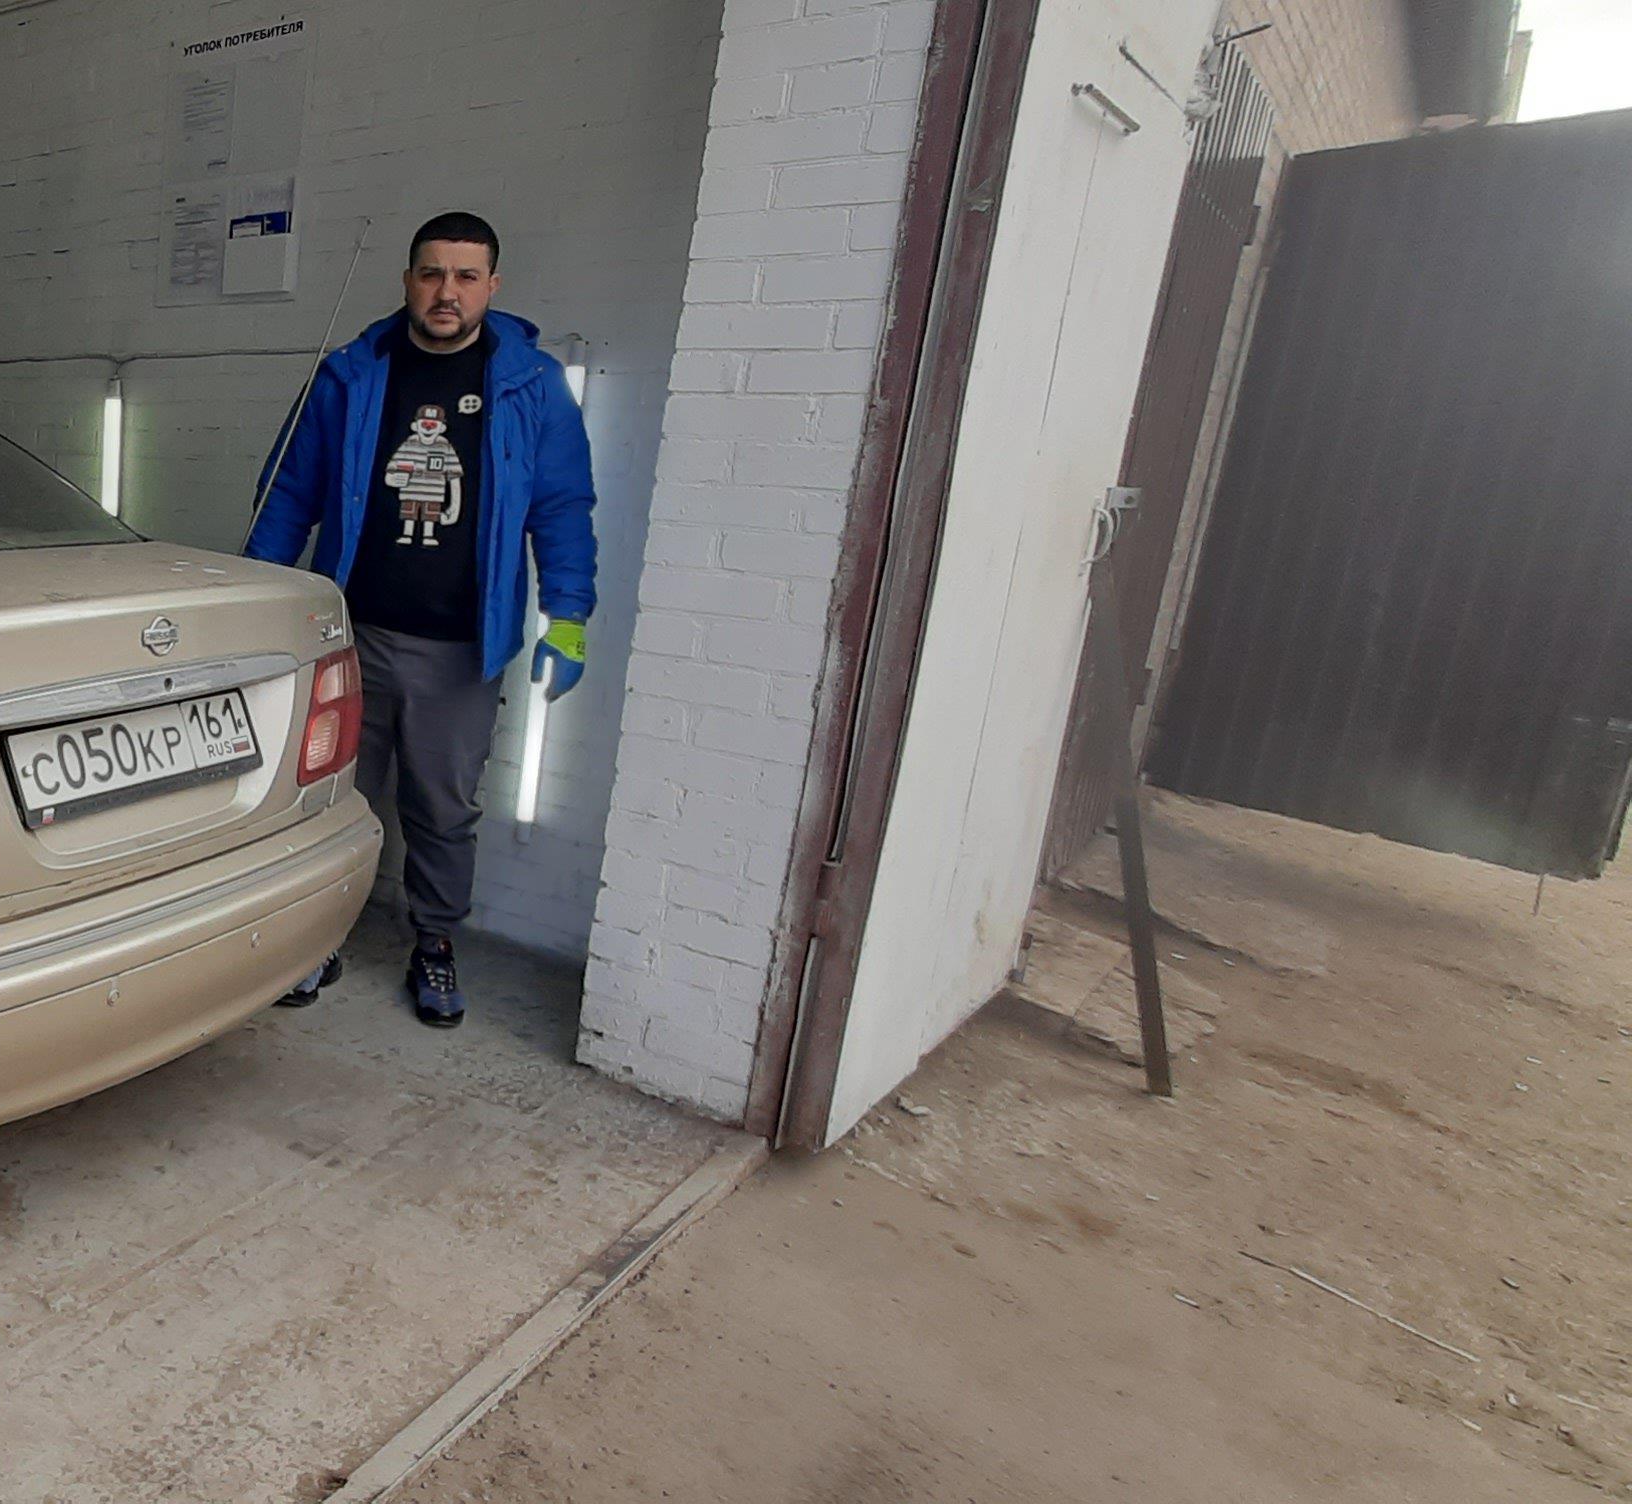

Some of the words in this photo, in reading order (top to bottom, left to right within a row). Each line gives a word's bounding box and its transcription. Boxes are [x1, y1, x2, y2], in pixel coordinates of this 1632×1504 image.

[183, 38, 223, 57] УГОЛОК
[224, 20, 304, 48] ПОТРЕБИТЕЛЯ
[189, 698, 240, 743] 161
[207, 741, 233, 759] RUS
